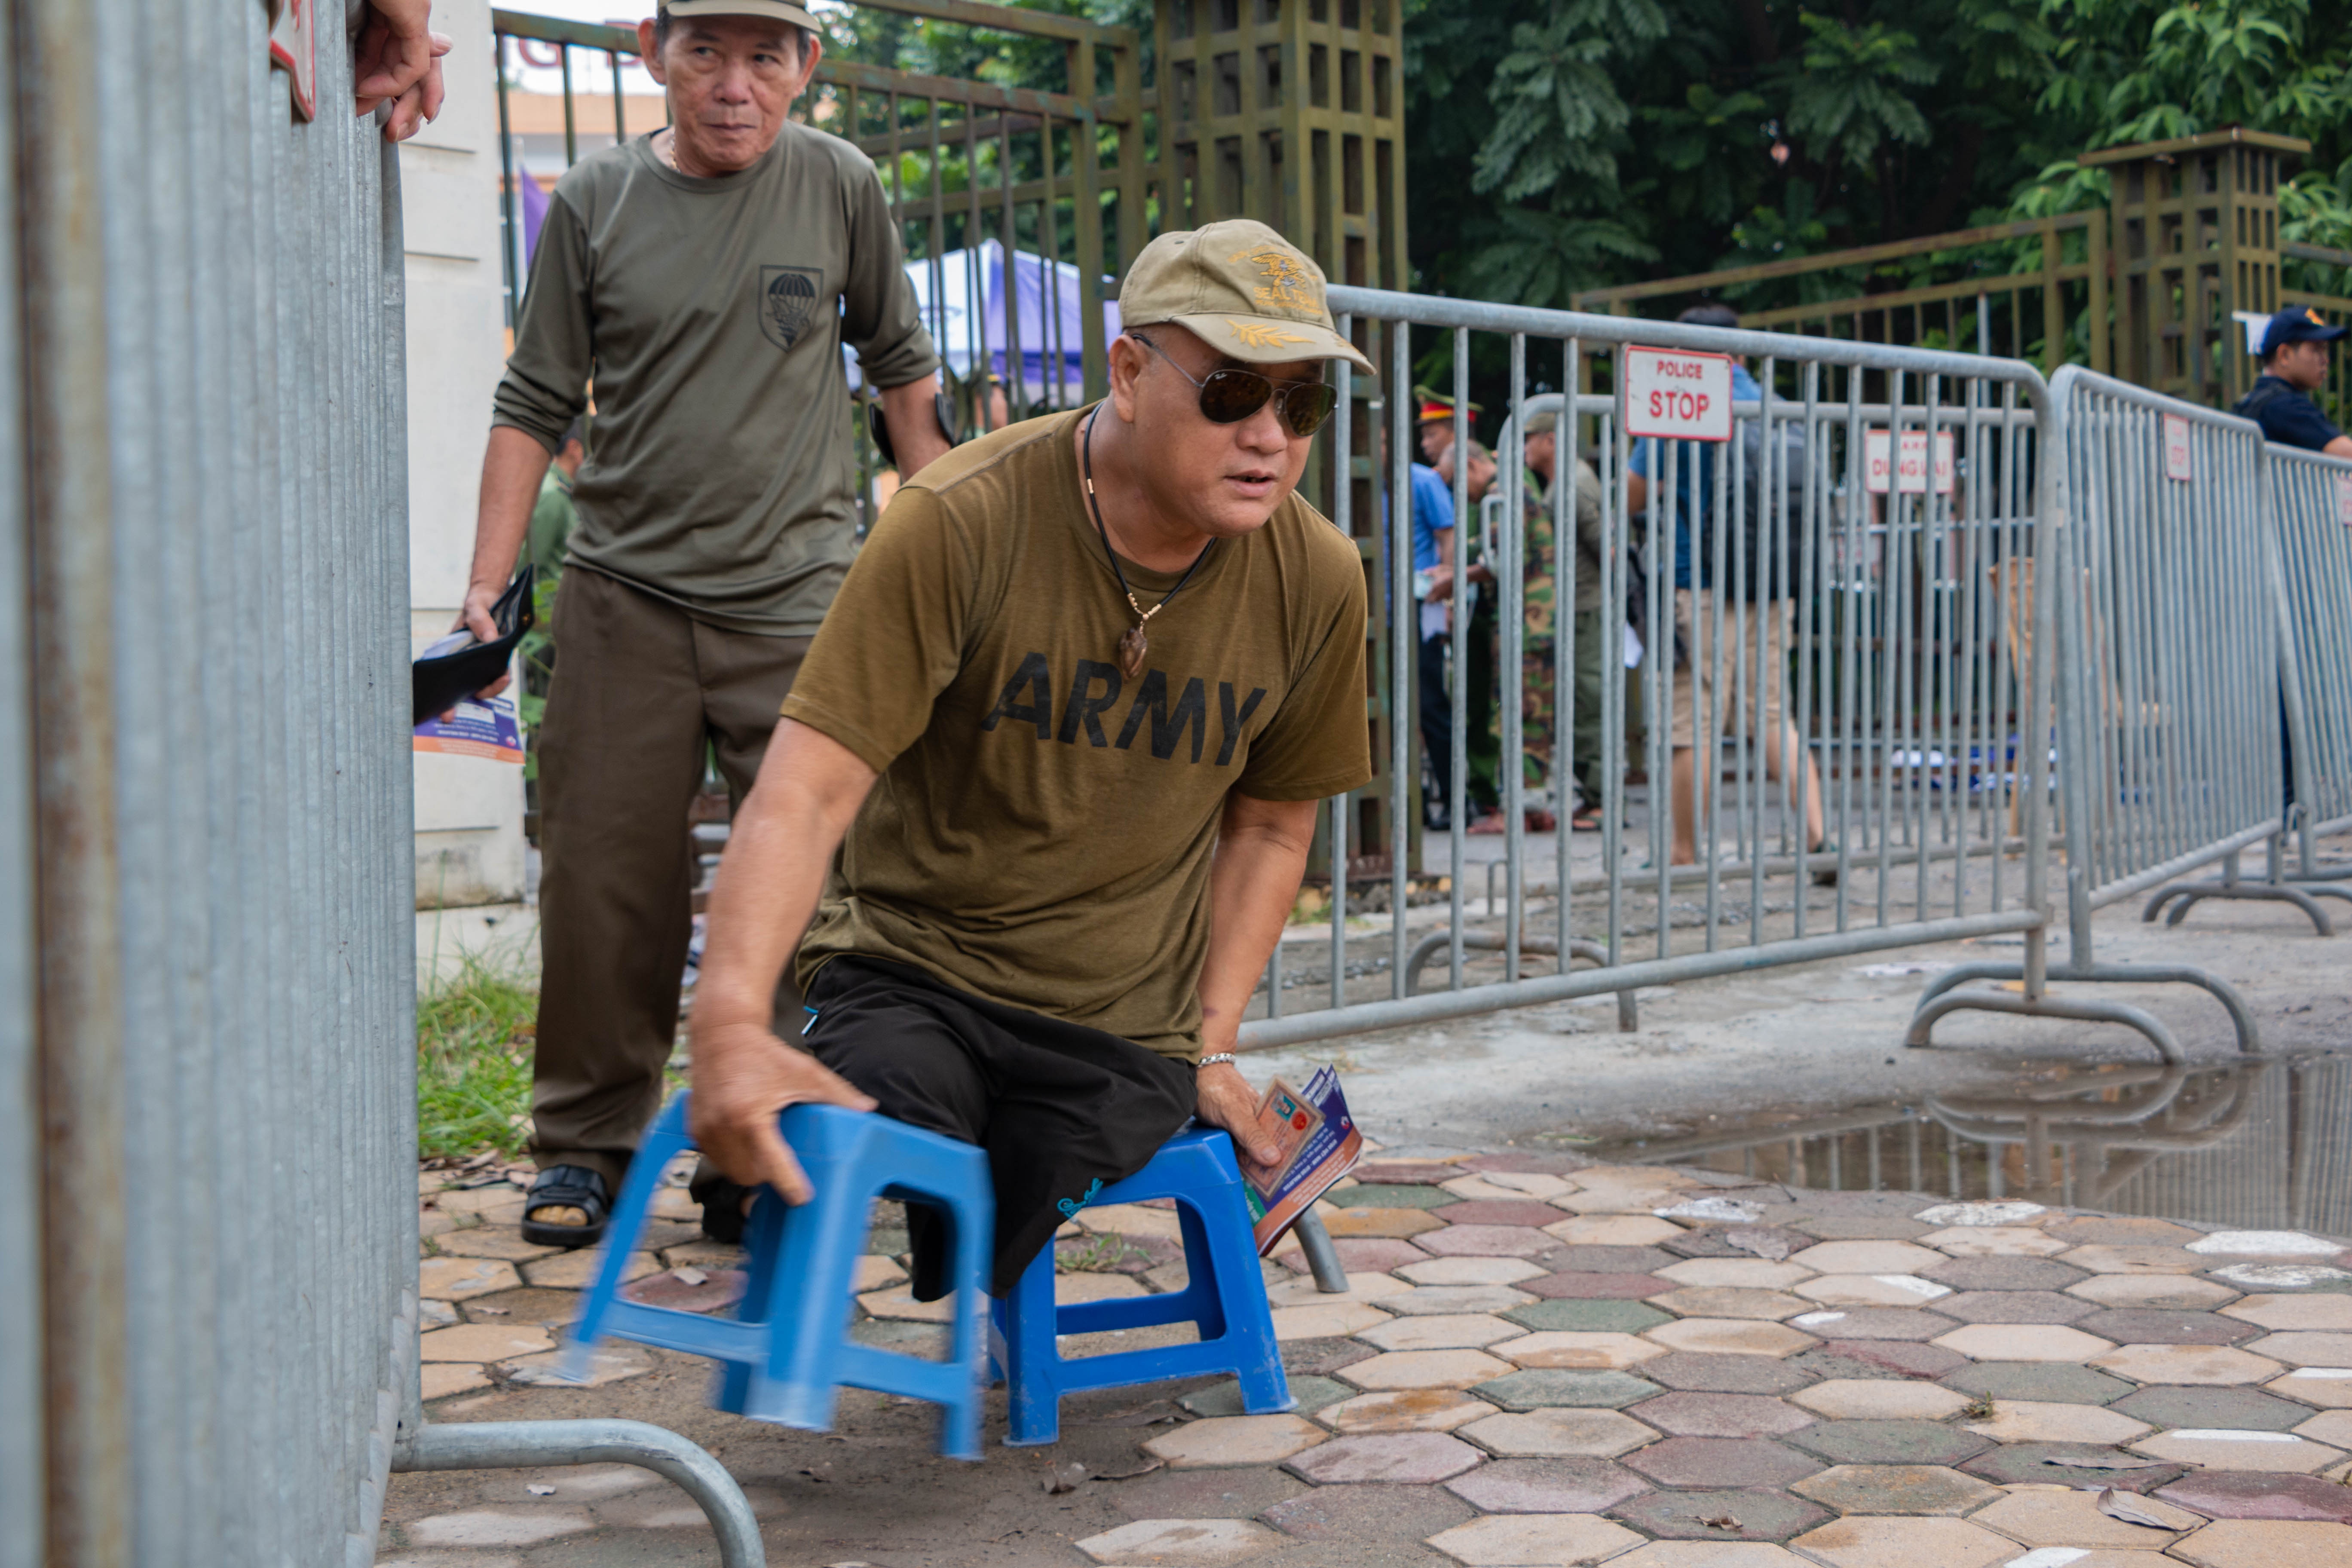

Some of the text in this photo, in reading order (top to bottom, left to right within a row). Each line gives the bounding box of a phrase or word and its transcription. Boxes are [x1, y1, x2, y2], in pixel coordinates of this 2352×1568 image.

[1253, 286, 1291, 300] SEAL
[1657, 360, 1703, 379] POLICE
[1650, 390, 1710, 421] STOP
[981, 652, 1267, 766] ARMY
